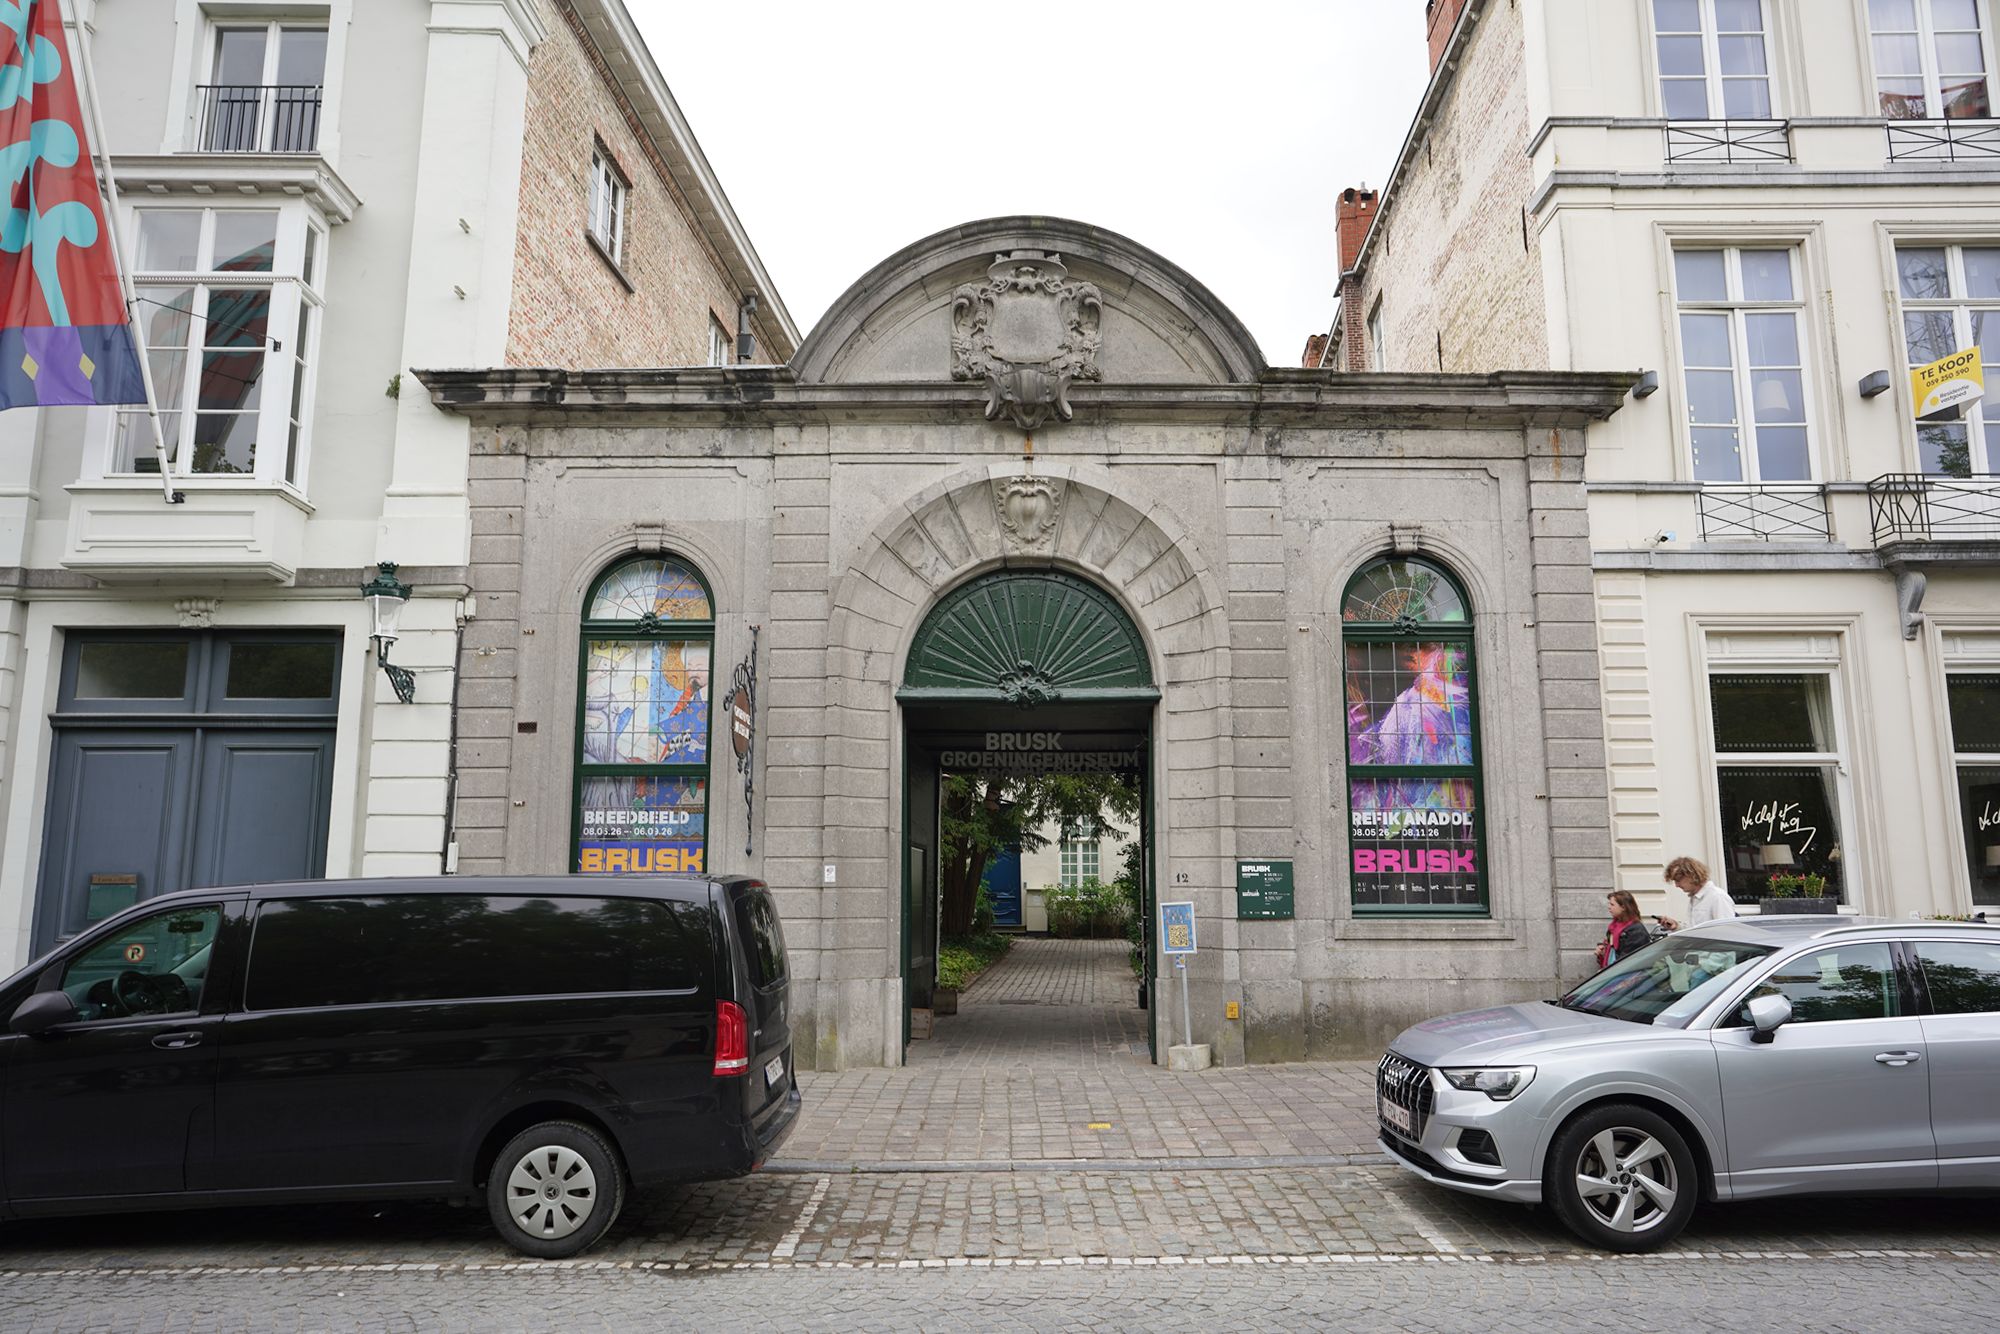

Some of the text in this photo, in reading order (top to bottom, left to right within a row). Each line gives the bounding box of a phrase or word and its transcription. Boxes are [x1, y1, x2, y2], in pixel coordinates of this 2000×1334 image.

[1920, 352, 1974, 380] TE KOOP
[1926, 367, 1969, 387] 059 250 590
[986, 732, 1062, 751] BRUSK
[940, 751, 1139, 767] GROENINGEMUSEUM
[584, 810, 690, 825] BREEDBEELD
[1403, 811, 1473, 826] ANADOL
[1352, 828, 1389, 837] 08.0526
[1402, 828, 1439, 837] 08.1126
[581, 848, 703, 872] BRUSK
[1354, 849, 1475, 873] BRUSK
[1241, 865, 1271, 873] BRUSK
[1176, 872, 1189, 883] 12
